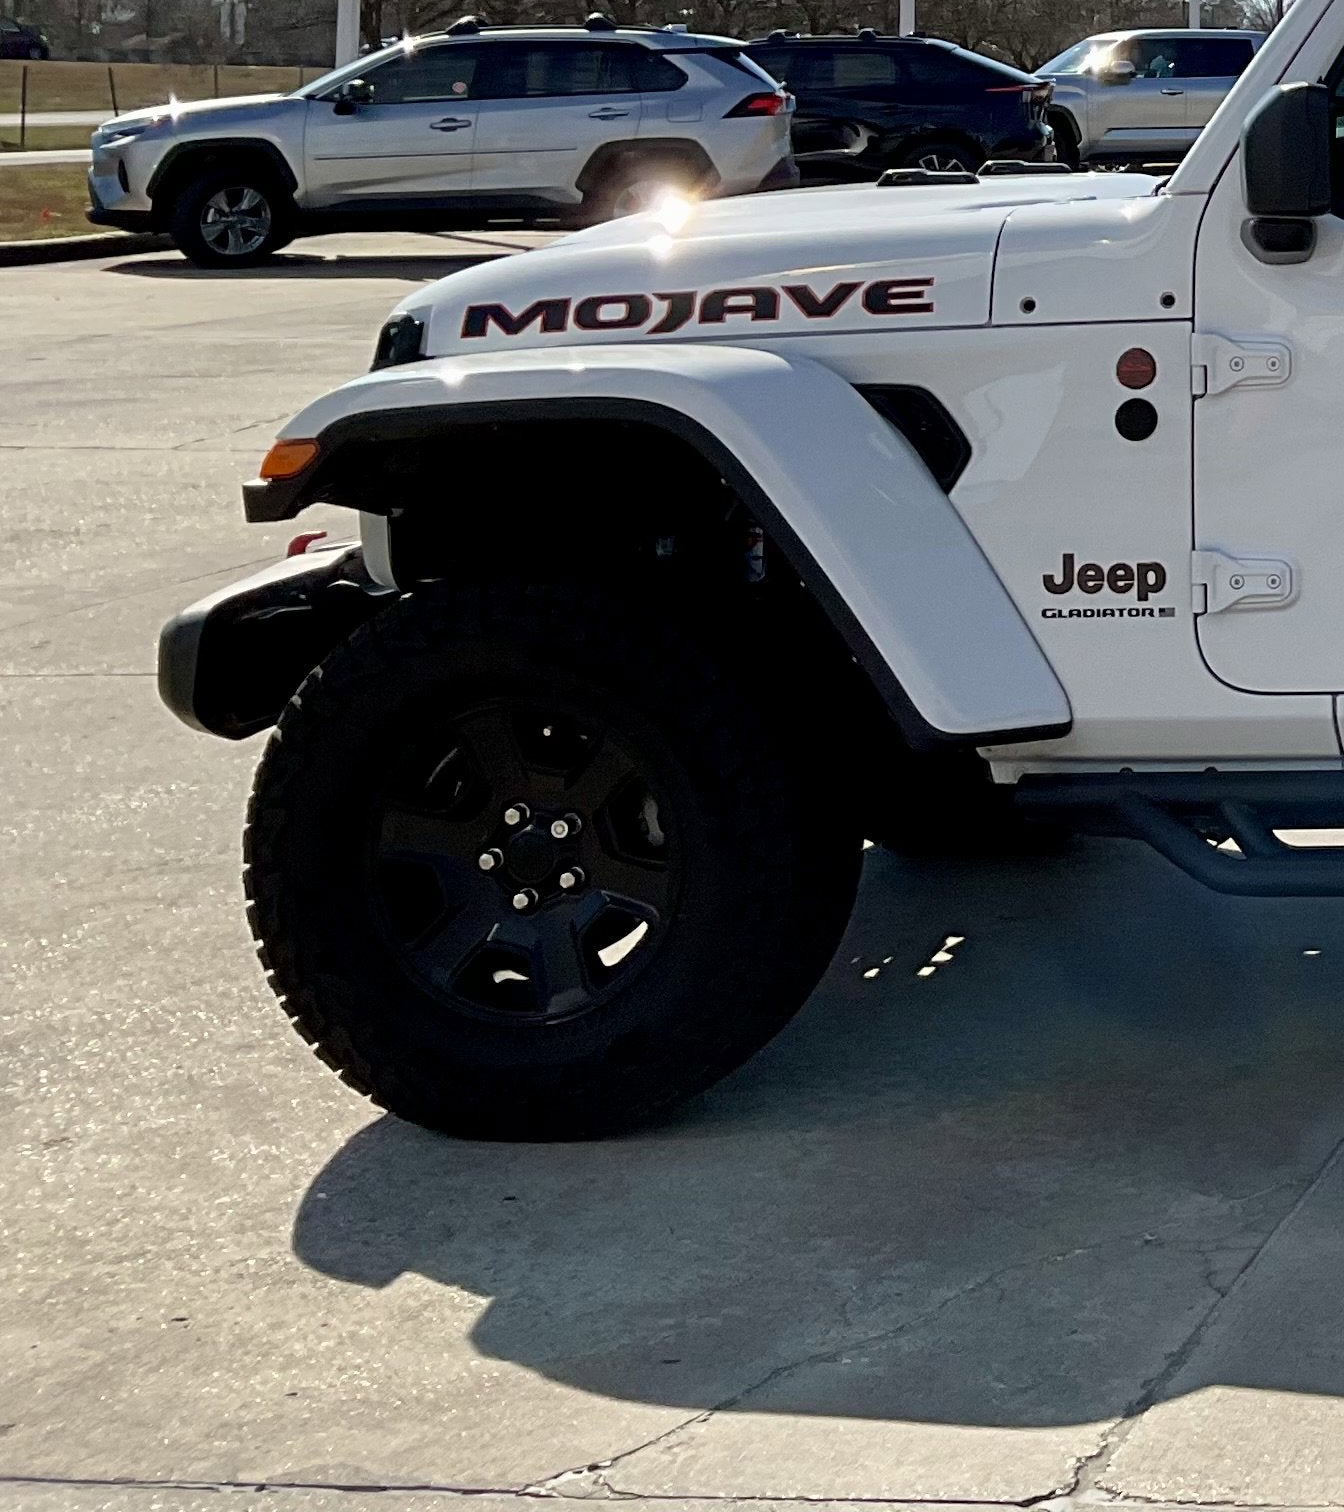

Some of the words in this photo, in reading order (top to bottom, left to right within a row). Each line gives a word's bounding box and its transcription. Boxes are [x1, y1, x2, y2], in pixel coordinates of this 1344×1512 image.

[460, 277, 935, 339] MOJAVE
[1042, 553, 1167, 601] Jeep
[1041, 607, 1155, 619] GLADIATOR
